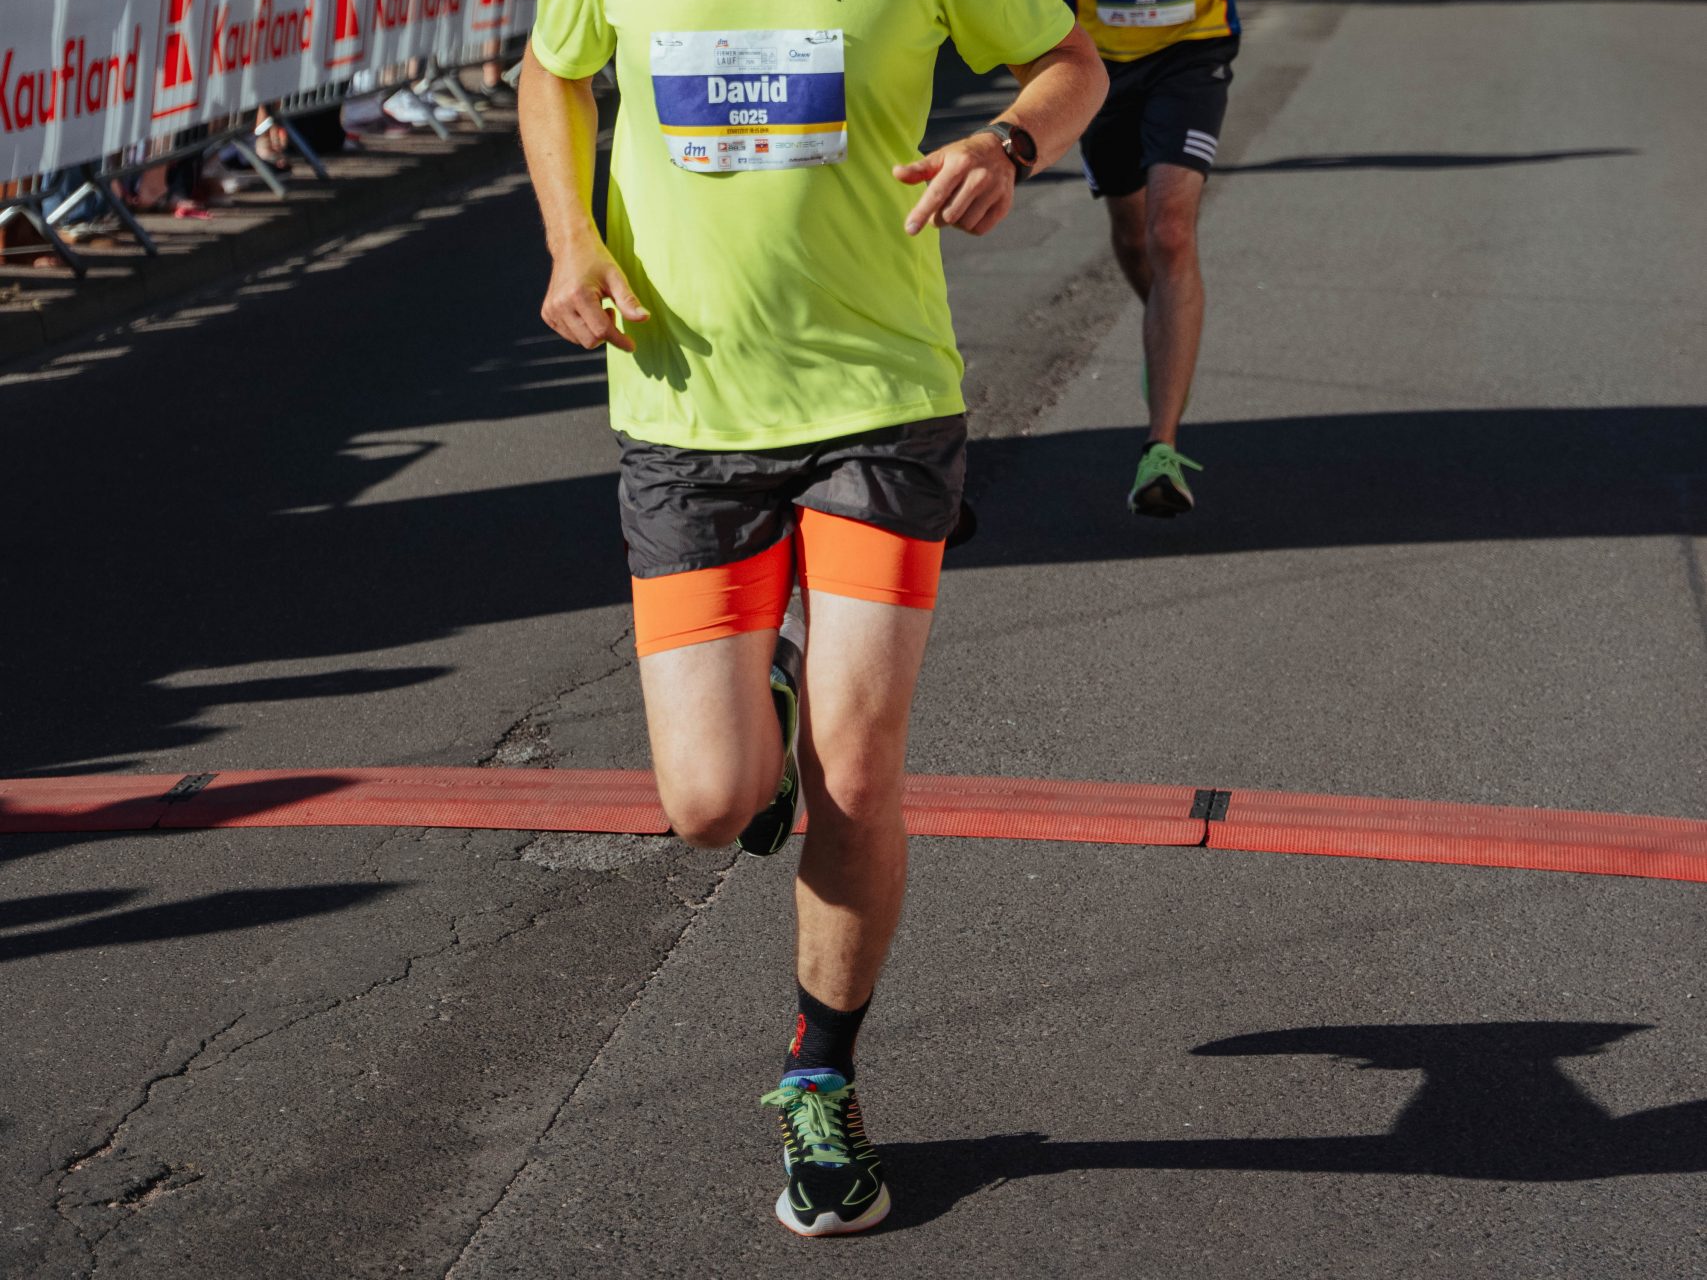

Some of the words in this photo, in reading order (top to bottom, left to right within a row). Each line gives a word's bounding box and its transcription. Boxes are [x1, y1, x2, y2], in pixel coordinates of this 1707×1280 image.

[0, 23, 141, 134] Kaufland
[707, 75, 787, 104] David
[729, 109, 768, 125] 6025
[683, 142, 706, 157] dm
